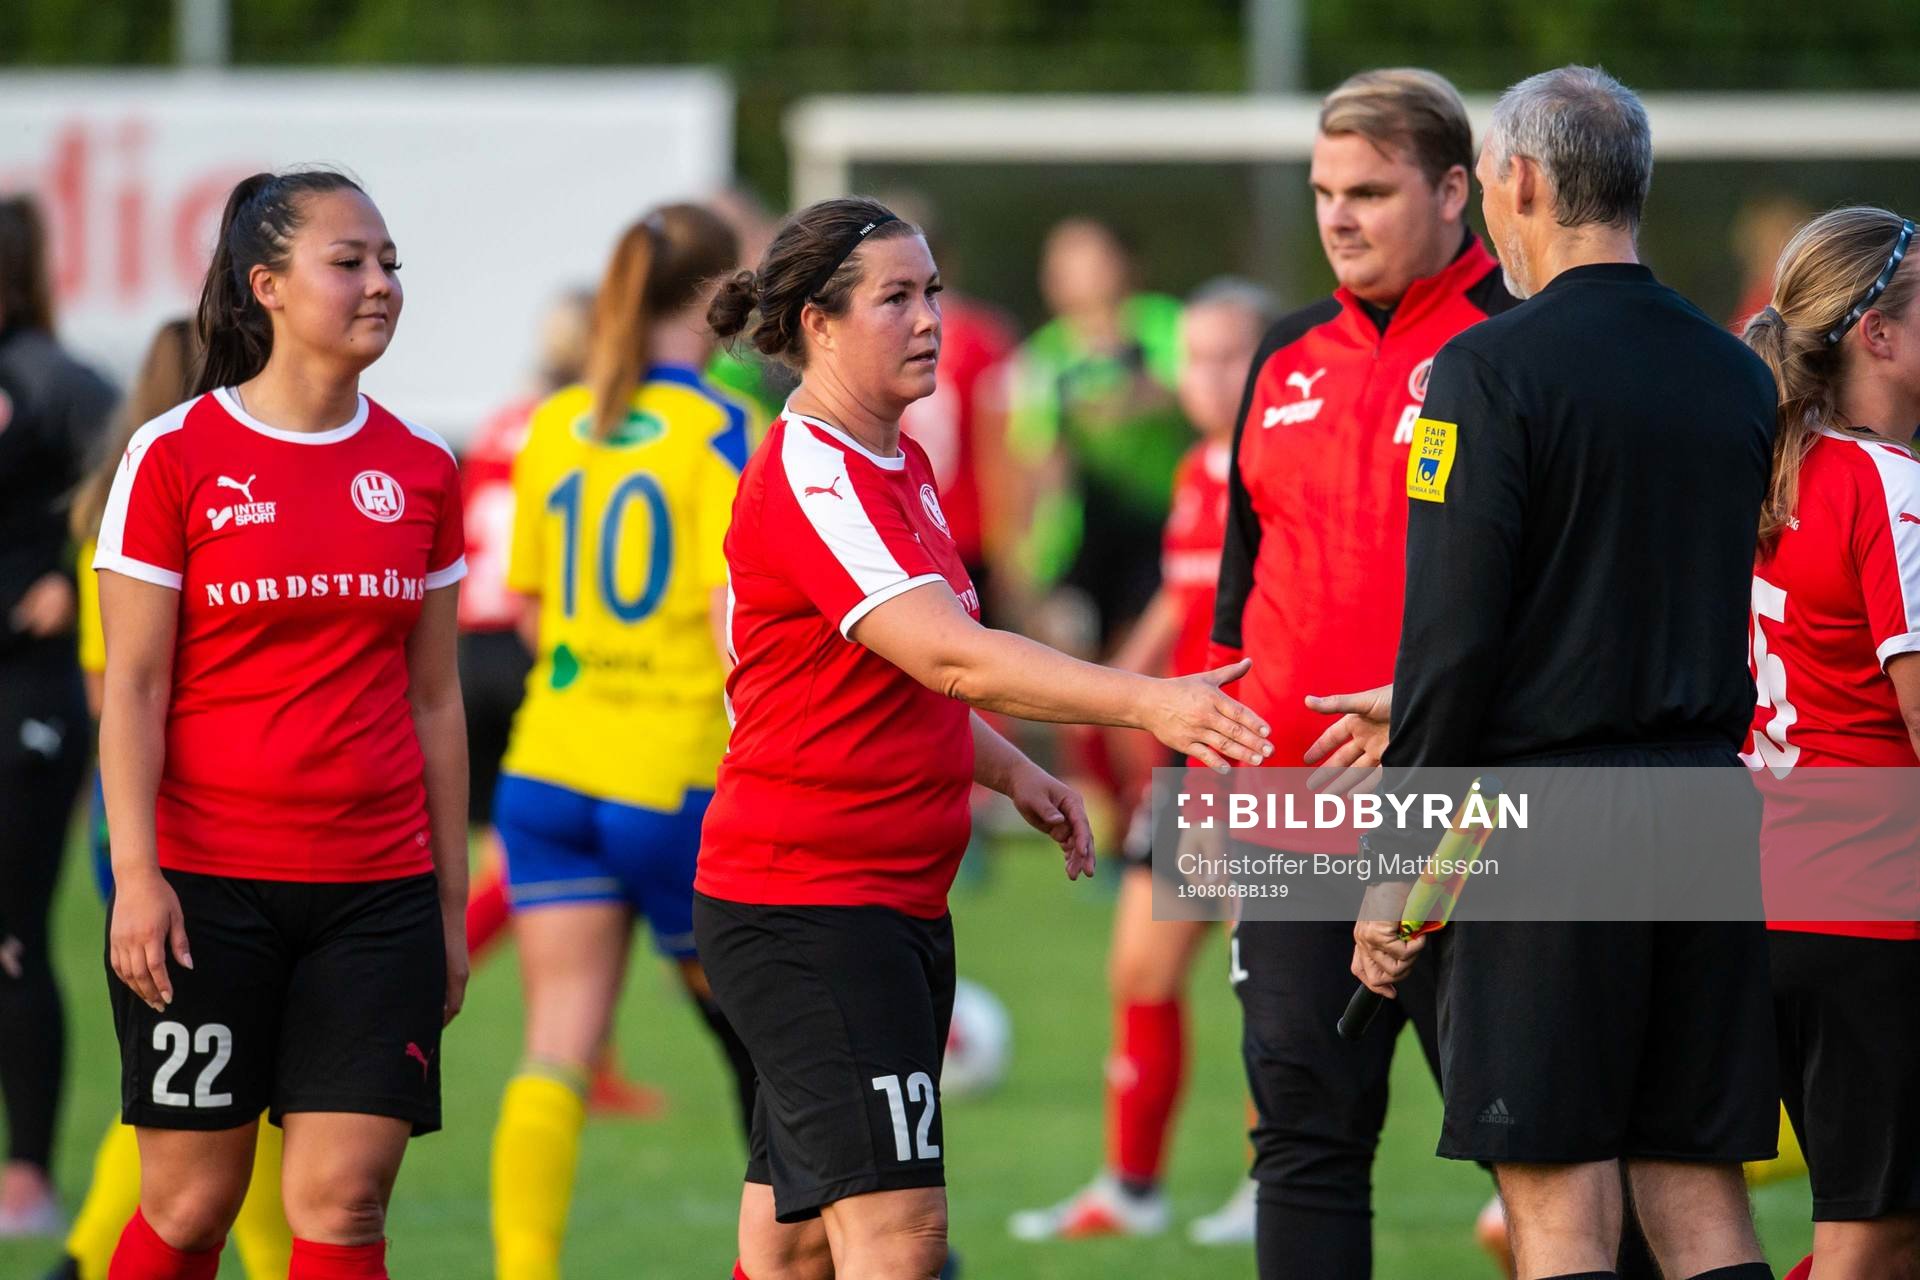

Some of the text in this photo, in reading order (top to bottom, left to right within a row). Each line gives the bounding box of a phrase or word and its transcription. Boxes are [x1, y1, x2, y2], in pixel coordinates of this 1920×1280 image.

[860, 222, 876, 236] NIKE
[1425, 426, 1447, 437] FAIR
[1423, 436, 1445, 447] PLAY
[1421, 446, 1444, 457] SvFF
[234, 501, 277, 515] INTER
[235, 512, 276, 526] SPORT
[546, 470, 675, 625] 10
[205, 568, 425, 606] NORDSTRÖMS
[152, 1021, 232, 1108] 22
[872, 1072, 940, 1162] 12
